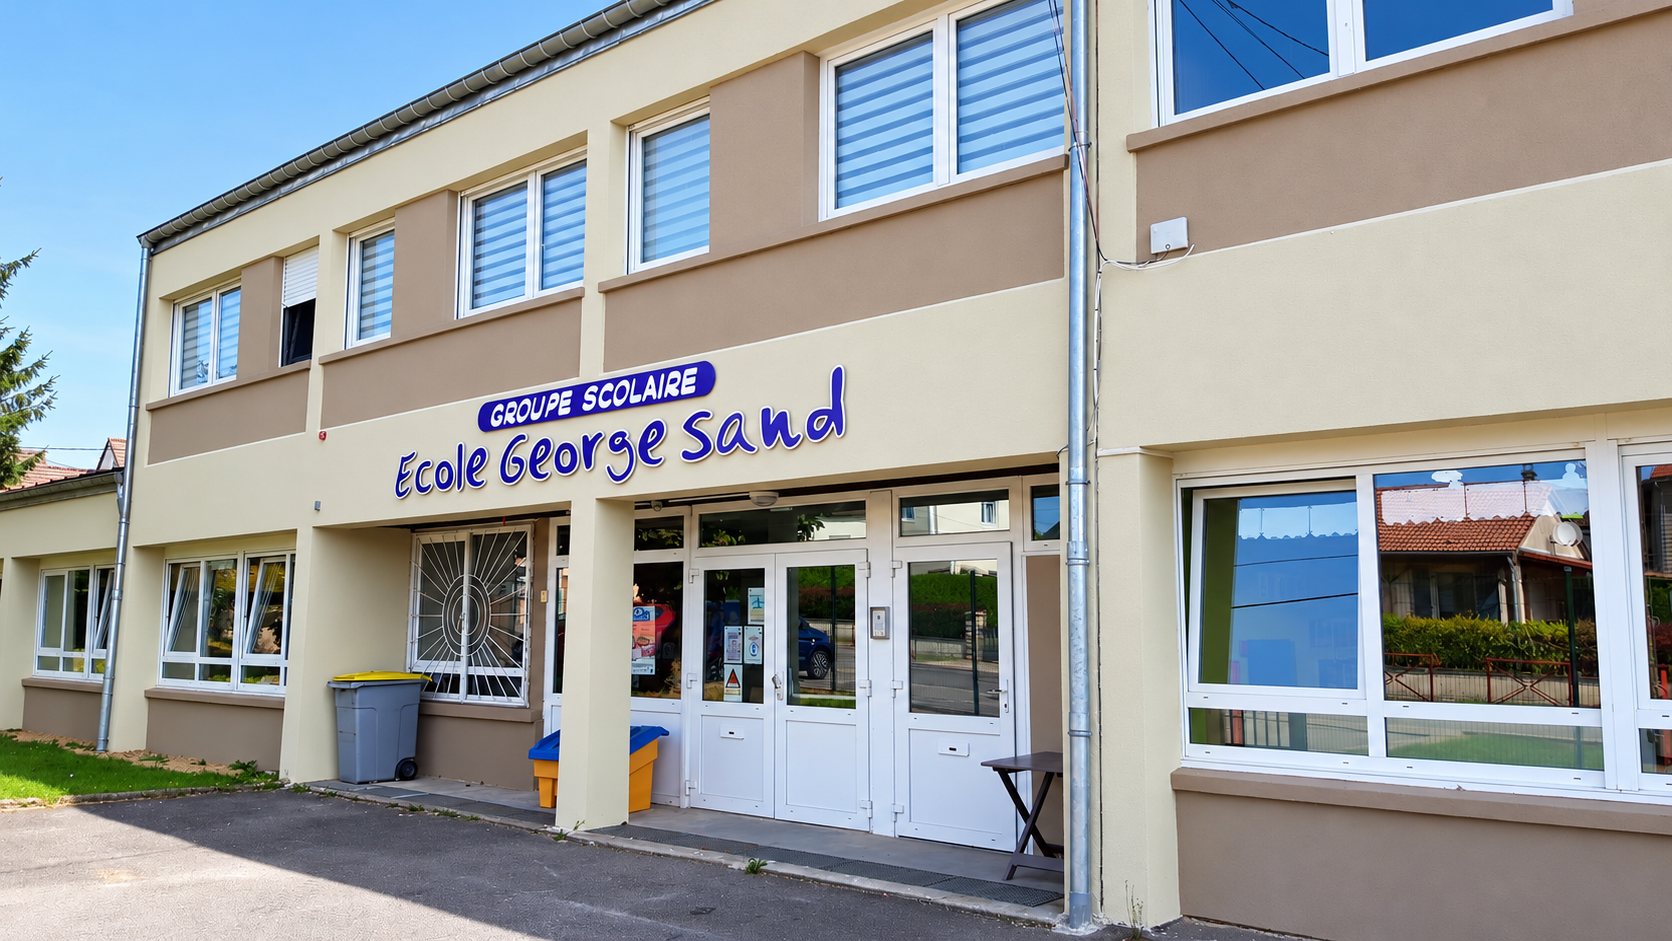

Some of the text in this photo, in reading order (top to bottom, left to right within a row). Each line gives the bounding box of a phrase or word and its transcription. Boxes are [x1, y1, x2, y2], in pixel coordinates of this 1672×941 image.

[490, 367, 698, 427] GROUPE SCOLAIRE
[394, 443, 487, 499] Ecole
[499, 419, 666, 484] George
